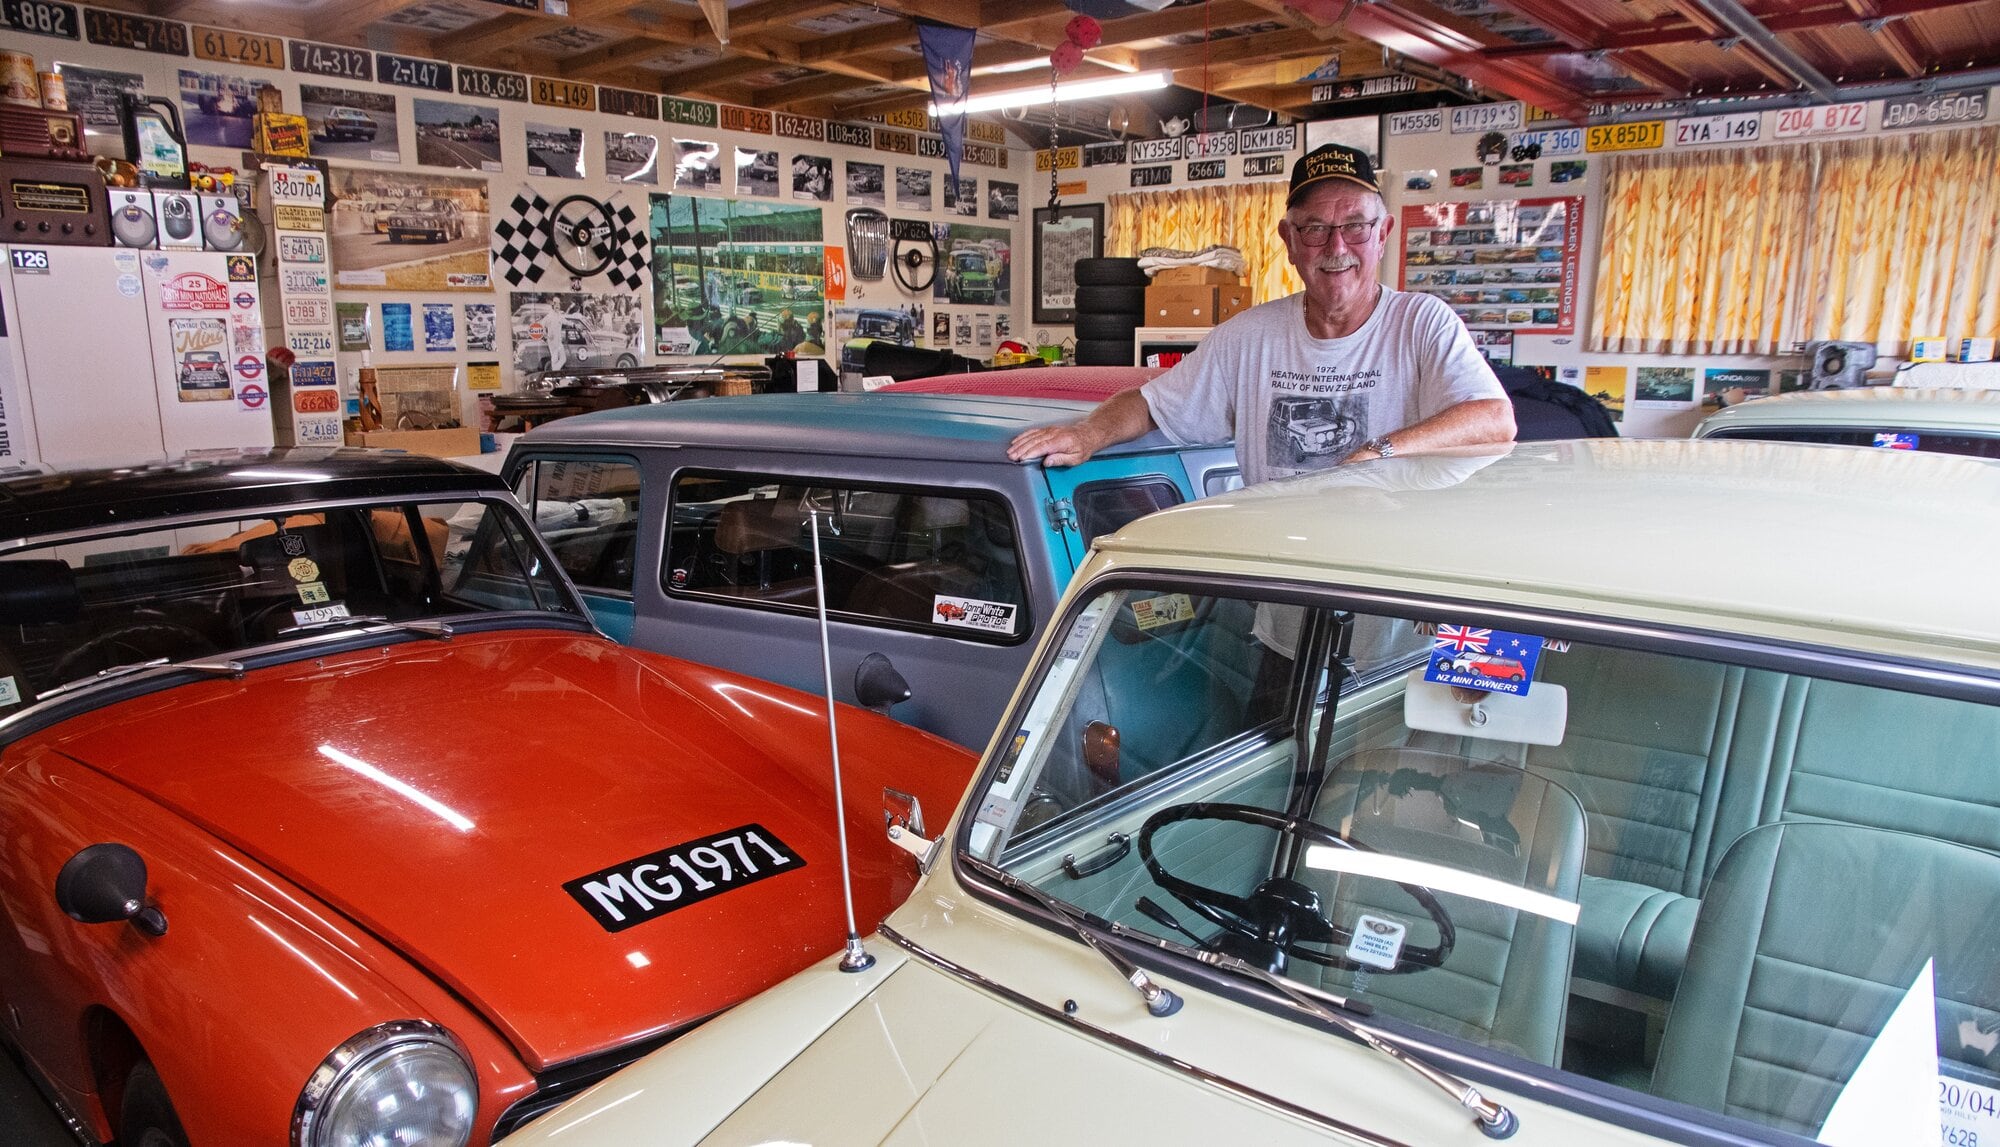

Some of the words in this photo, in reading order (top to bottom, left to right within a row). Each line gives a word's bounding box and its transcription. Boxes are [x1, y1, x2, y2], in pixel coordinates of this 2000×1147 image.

[1391, 114, 1440, 131] TW5536
[1243, 131, 1293, 149] DKM185
[1133, 141, 1179, 159] NY3554
[1305, 150, 1355, 169] Beaded
[1307, 162, 1357, 178] Wheels
[1568, 201, 1580, 252] HOLDEN
[14, 252, 47, 268] 126
[188, 280, 201, 288] 25
[1563, 256, 1576, 314] LEGENDS
[176, 330, 224, 353] Mini
[292, 338, 331, 350] 312-216
[1271, 370, 1310, 382] HEATWAY
[1311, 369, 1382, 383] INTERNATIONAL
[1316, 366, 1337, 374] 1972
[1712, 374, 1744, 382] HONDA
[1271, 380, 1297, 390] RALLY
[1300, 383, 1310, 392] OF
[1312, 384, 1334, 393] NEW
[1335, 380, 1376, 392] ZEALAND
[983, 604, 1005, 616] White
[971, 614, 1009, 626] PHOTOS
[1436, 673, 1451, 683] NZ
[1451, 675, 1473, 685] MINI
[1474, 678, 1519, 693] OWNERS
[582, 831, 790, 922] MG1971
